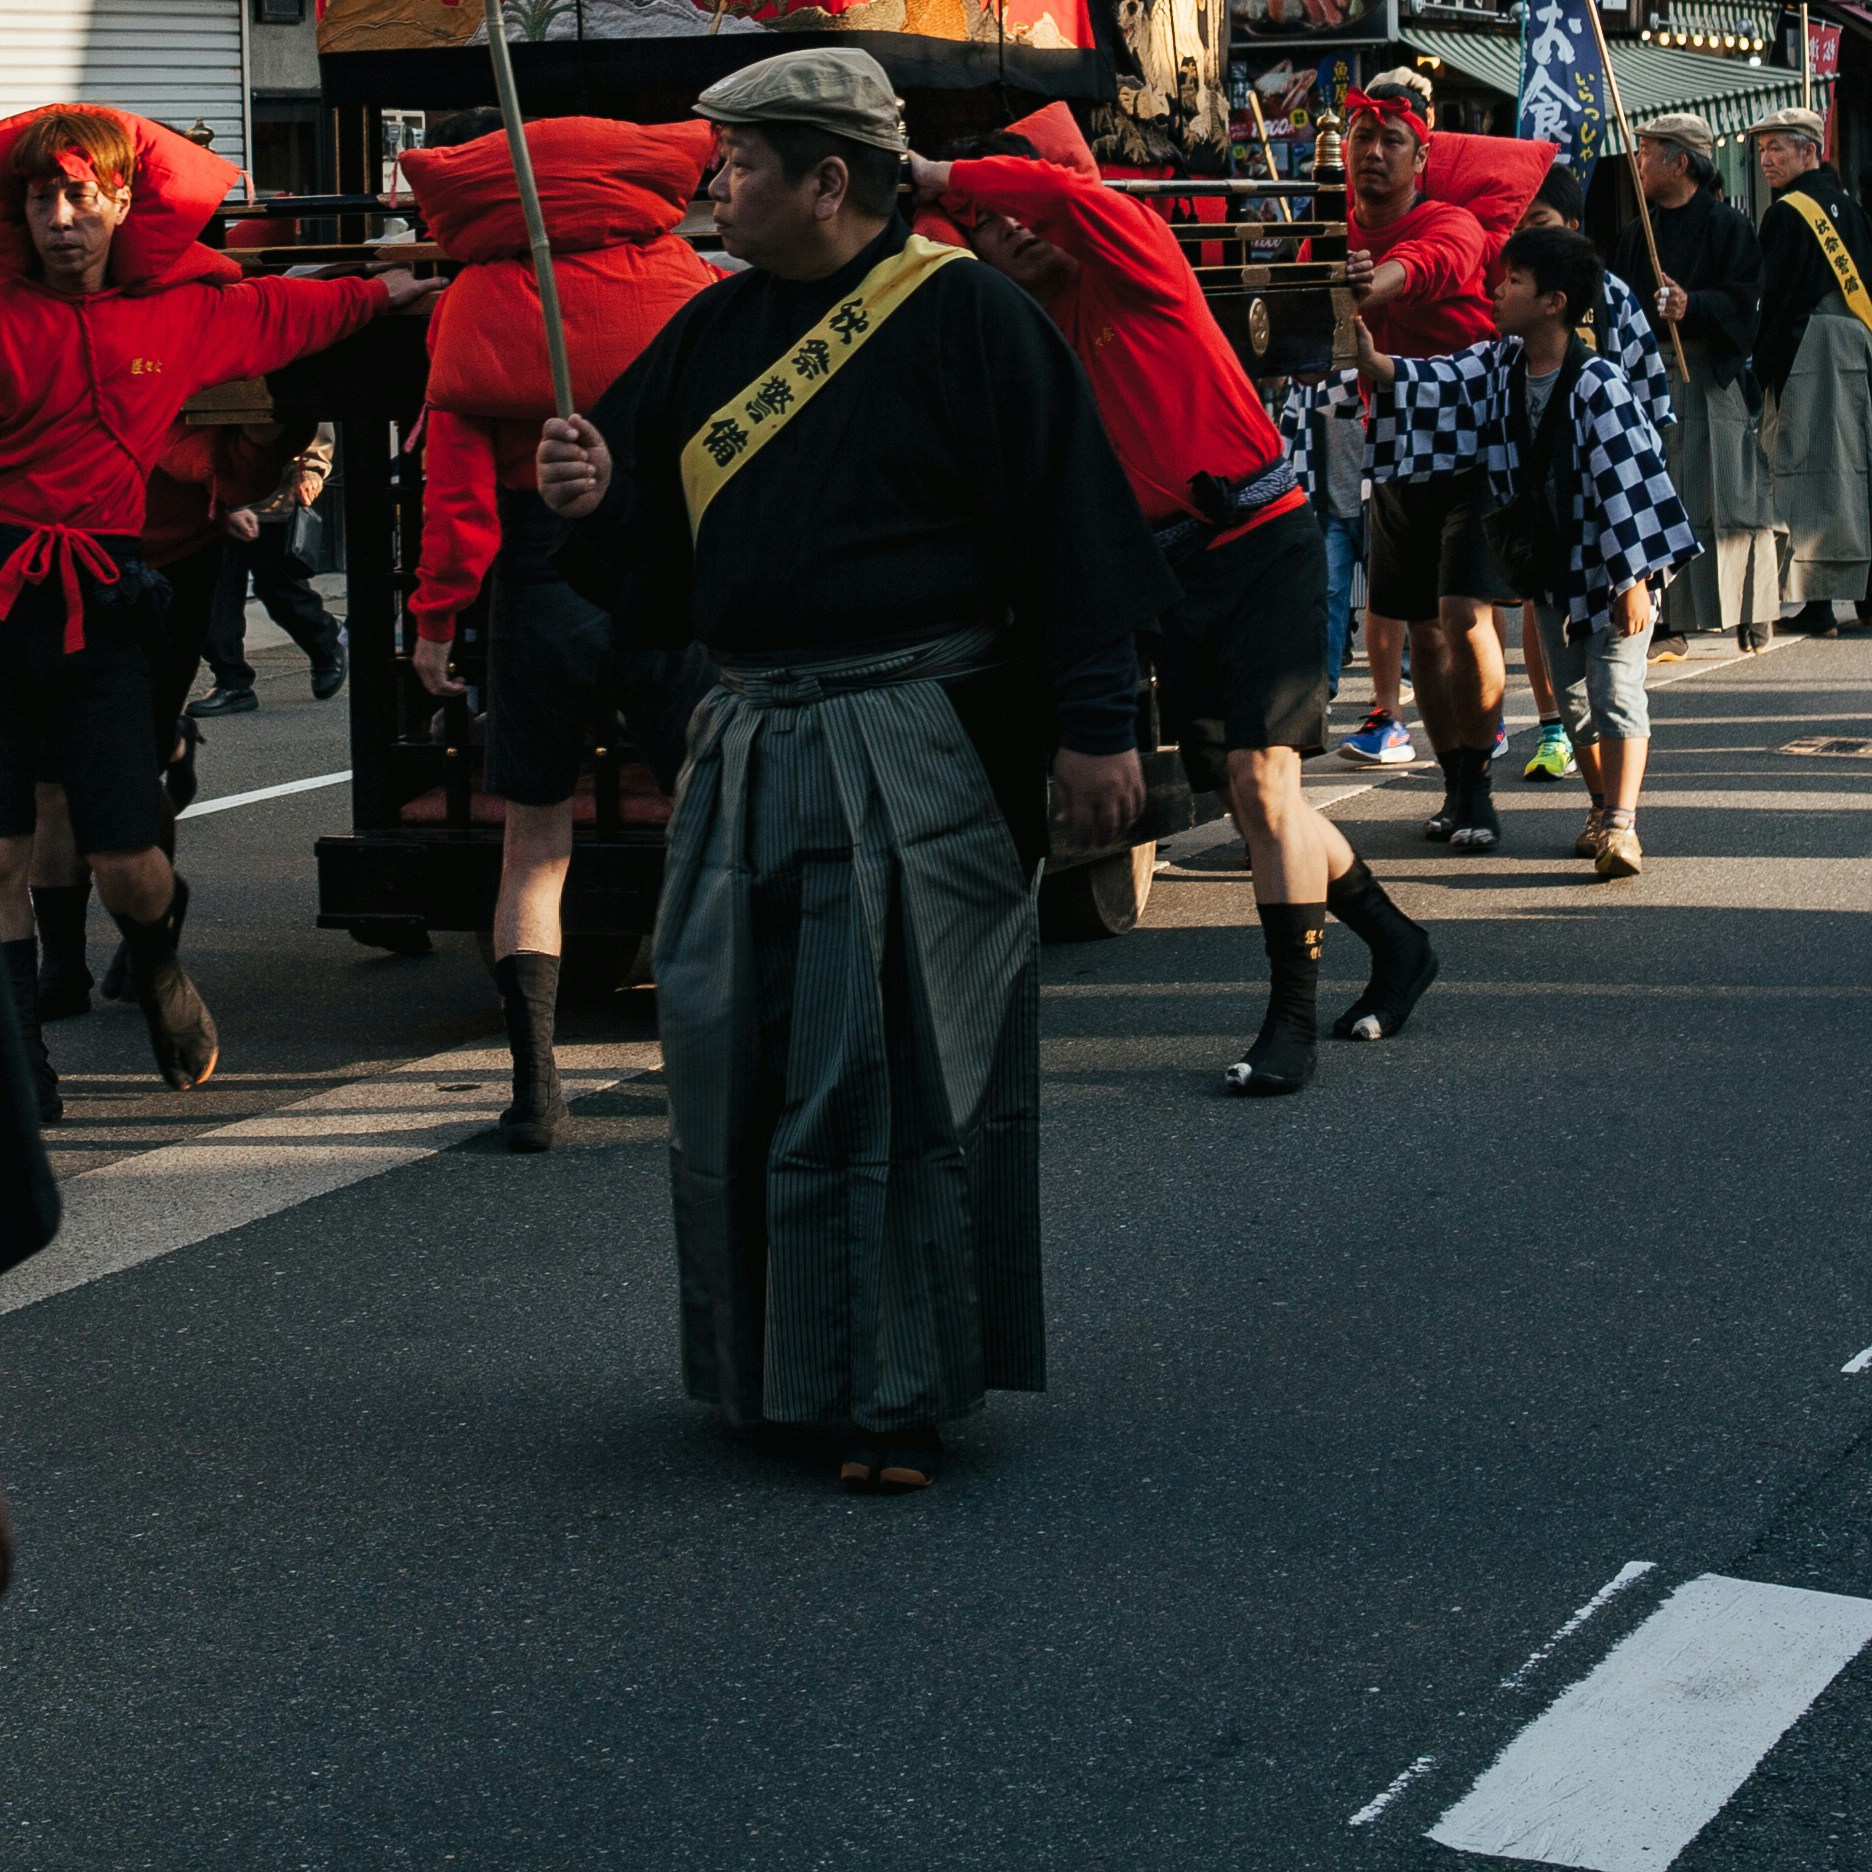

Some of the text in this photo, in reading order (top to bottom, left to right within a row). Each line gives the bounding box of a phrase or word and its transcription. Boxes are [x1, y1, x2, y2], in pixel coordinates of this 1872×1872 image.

[1521, 0, 1582, 164] お食
[701, 297, 871, 469] 秋祭警備
